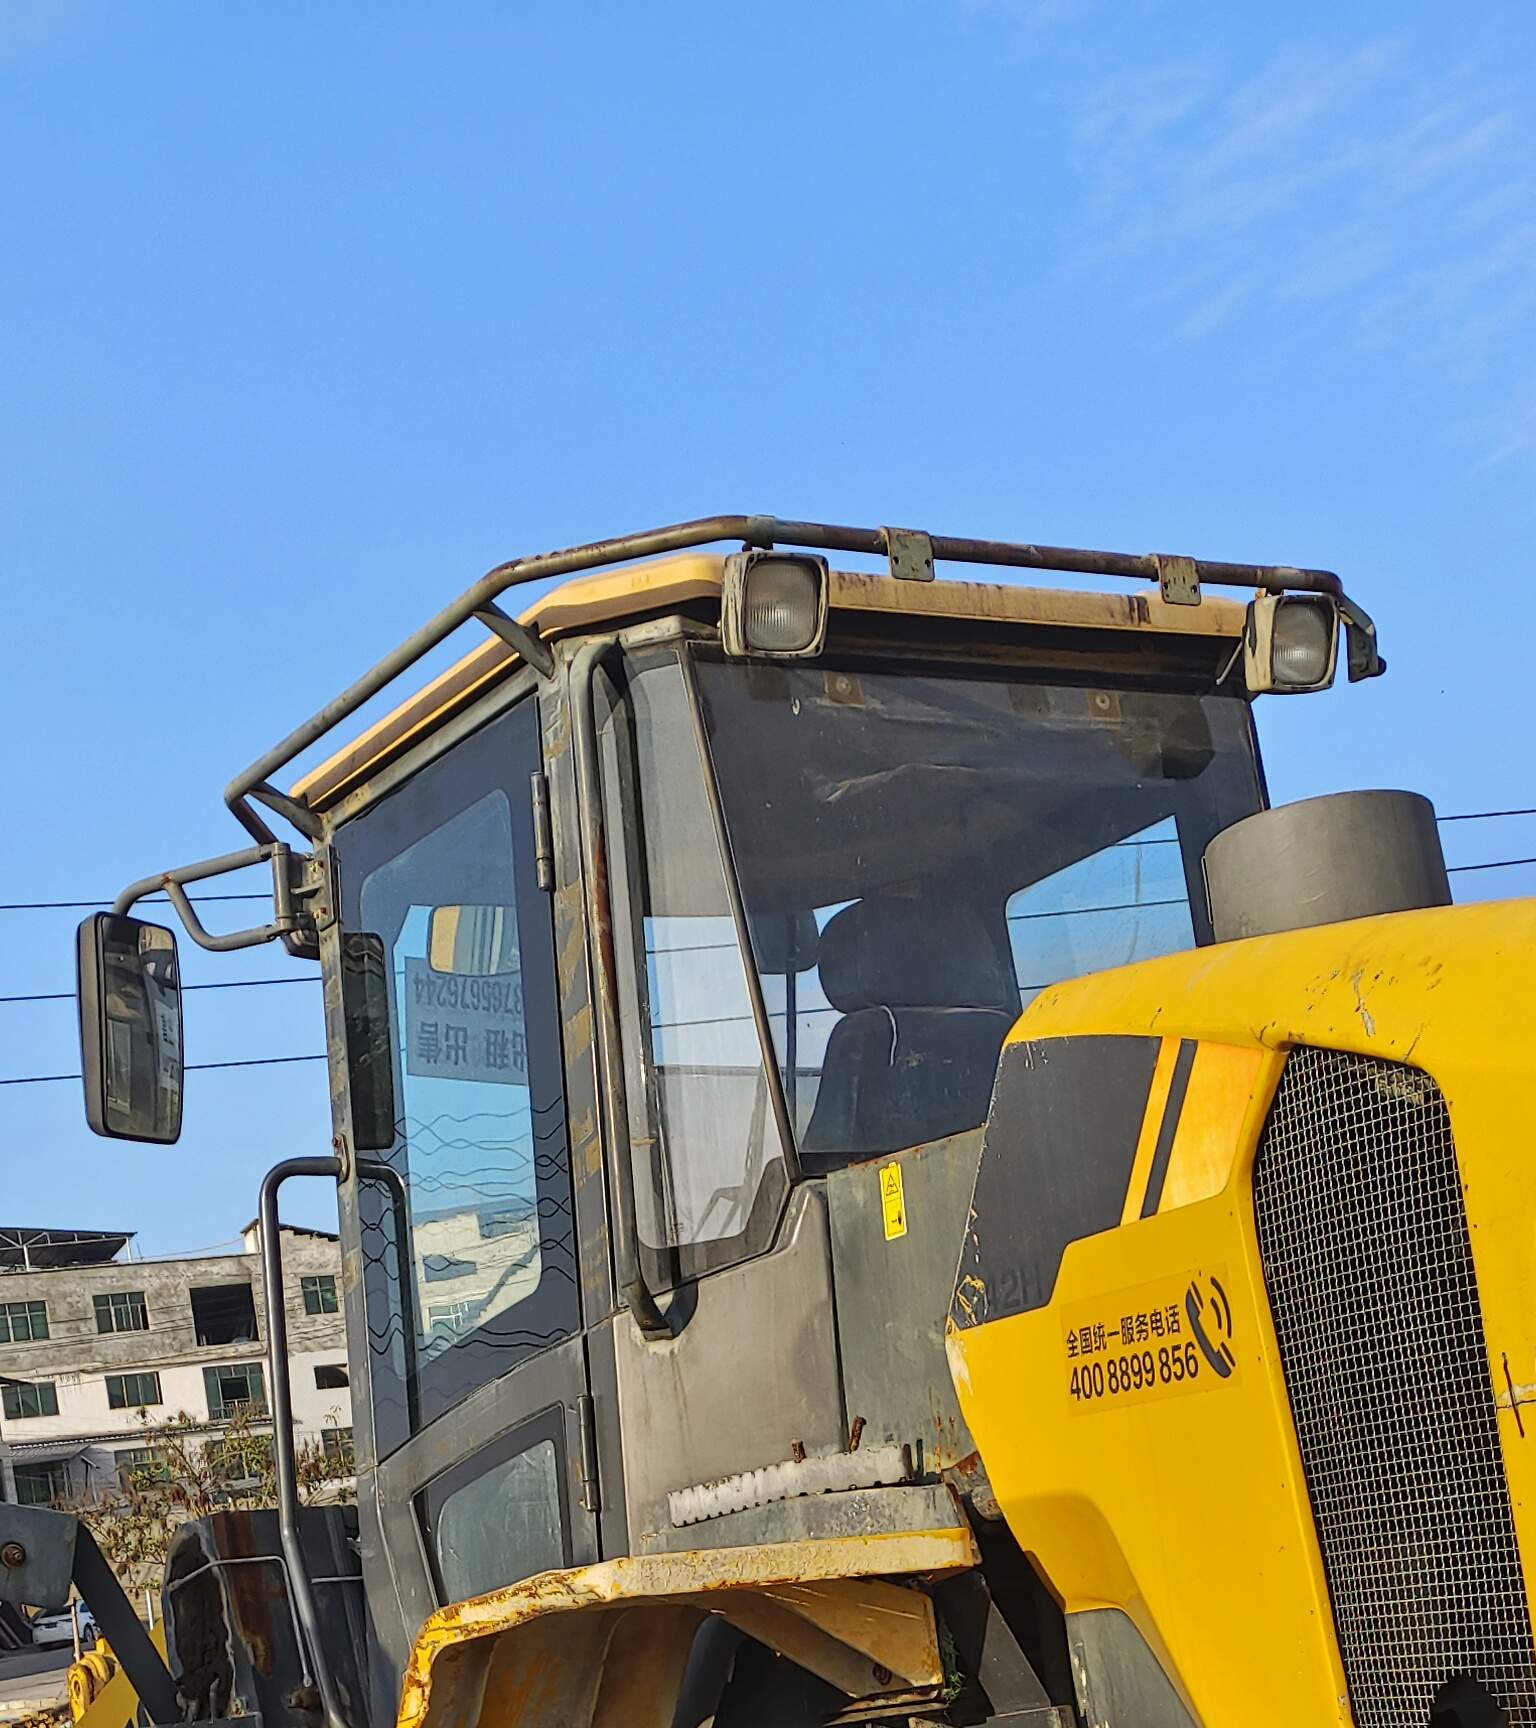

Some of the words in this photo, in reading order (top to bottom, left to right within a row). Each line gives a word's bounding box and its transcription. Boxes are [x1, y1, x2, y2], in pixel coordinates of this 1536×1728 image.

[417, 1021, 468, 1067] 出售
[1066, 1304, 1181, 1359] 全国统一服务电话
[1070, 1362, 1104, 1401] 400
[1107, 1351, 1155, 1394] 8899
[1158, 1341, 1199, 1384] 856
